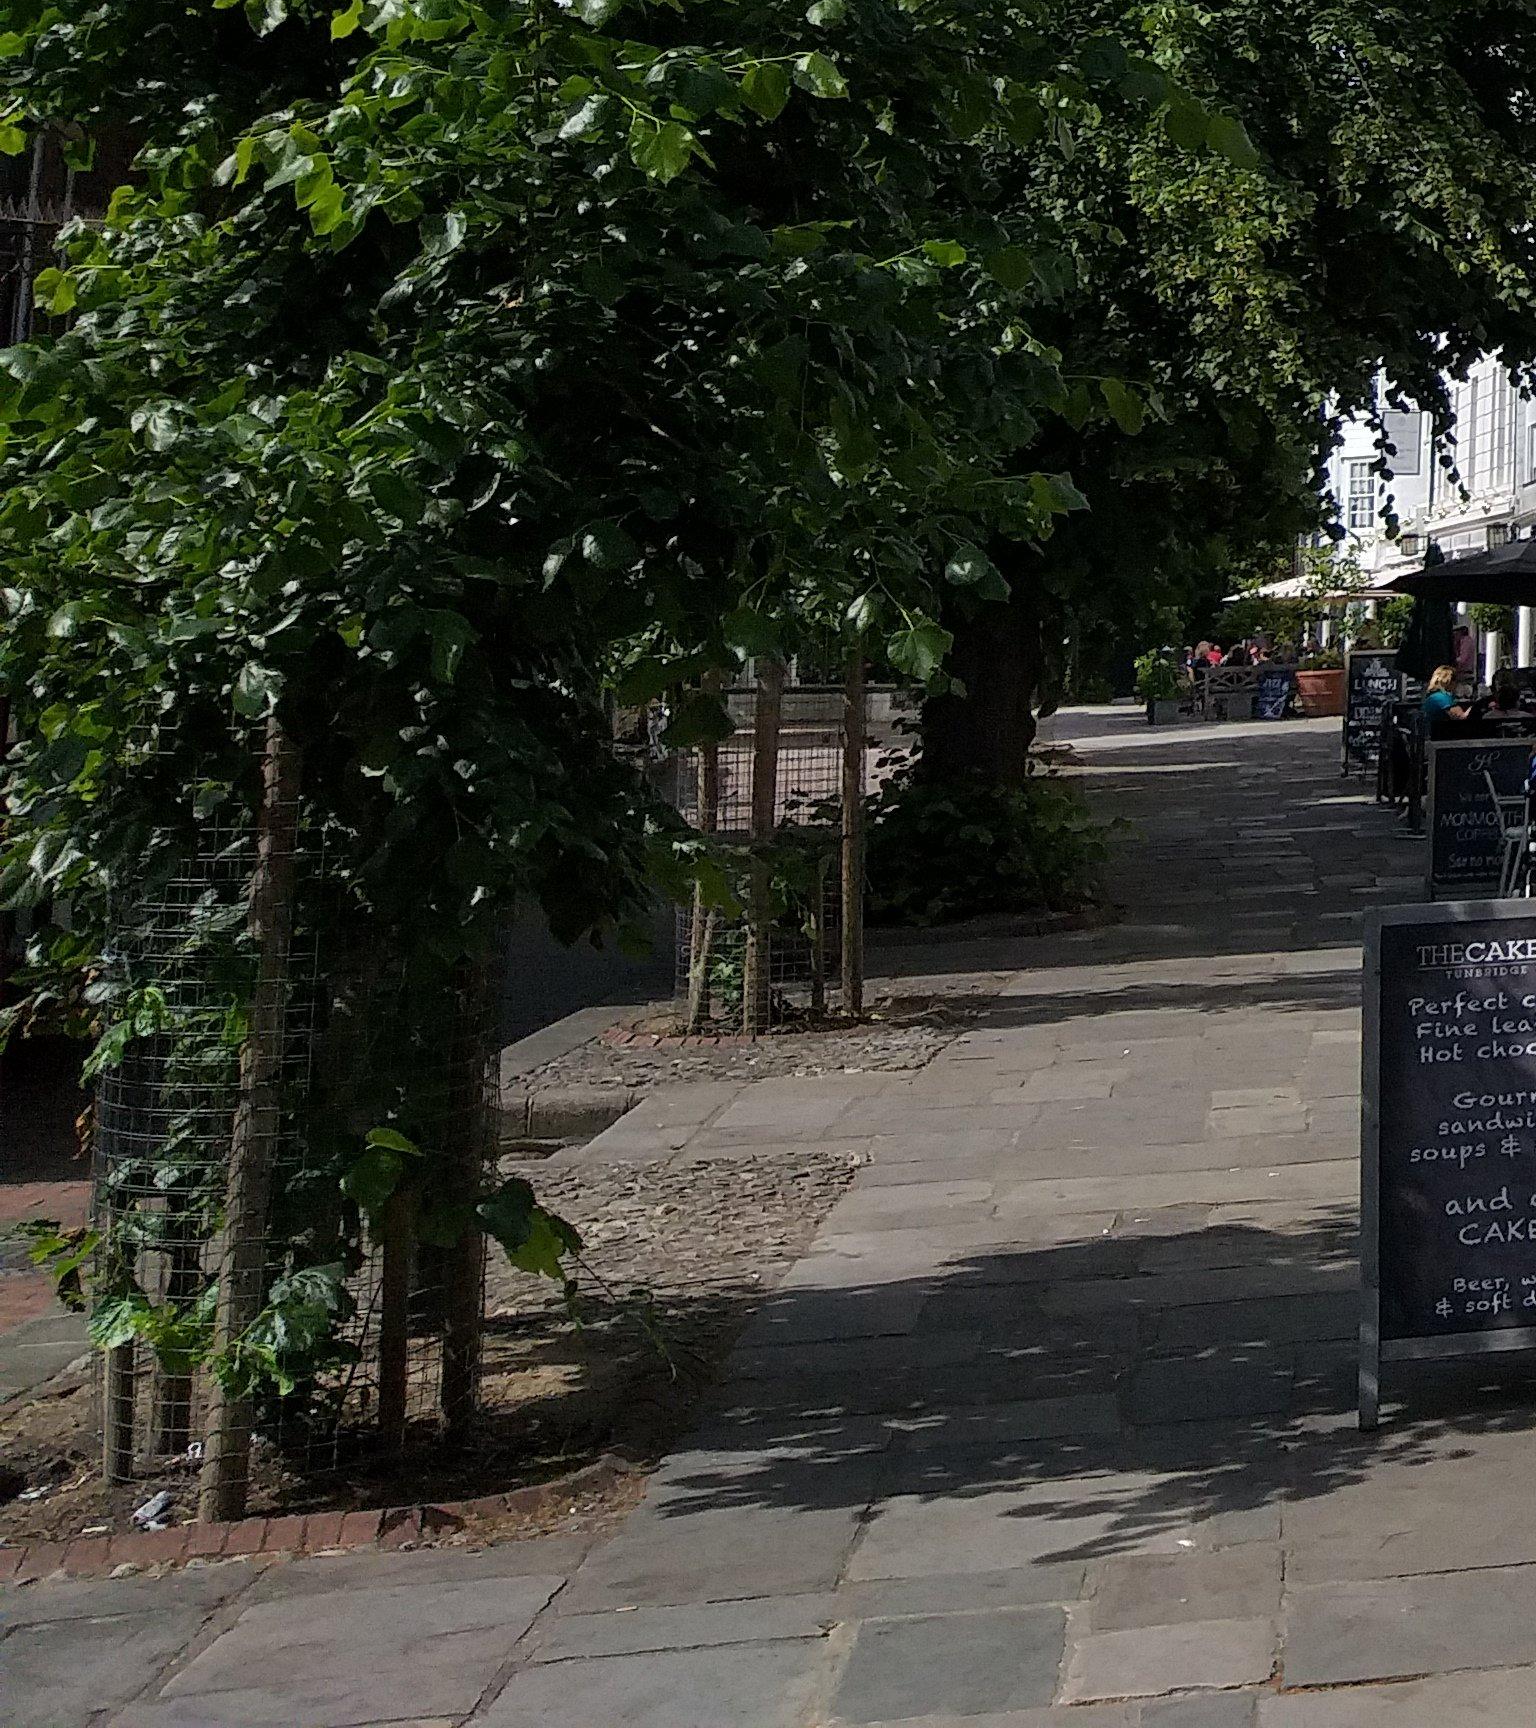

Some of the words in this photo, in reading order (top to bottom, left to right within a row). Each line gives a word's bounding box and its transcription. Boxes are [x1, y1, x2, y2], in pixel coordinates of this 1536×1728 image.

[1354, 678, 1398, 691] LUNCH
[1440, 810, 1525, 827] MONMOTH
[1446, 964, 1528, 980] TUNBRIDGE
[1408, 990, 1509, 1018] Perfect
[1416, 1020, 1479, 1039] Fine
[1419, 1042, 1464, 1063] Hot
[1409, 1141, 1487, 1170] soups
[1499, 1133, 1522, 1159] &
[1444, 1186, 1514, 1216] and
[1452, 1276, 1511, 1293] Beer,
[1434, 1296, 1454, 1319] &
[1464, 1291, 1513, 1315] soft
